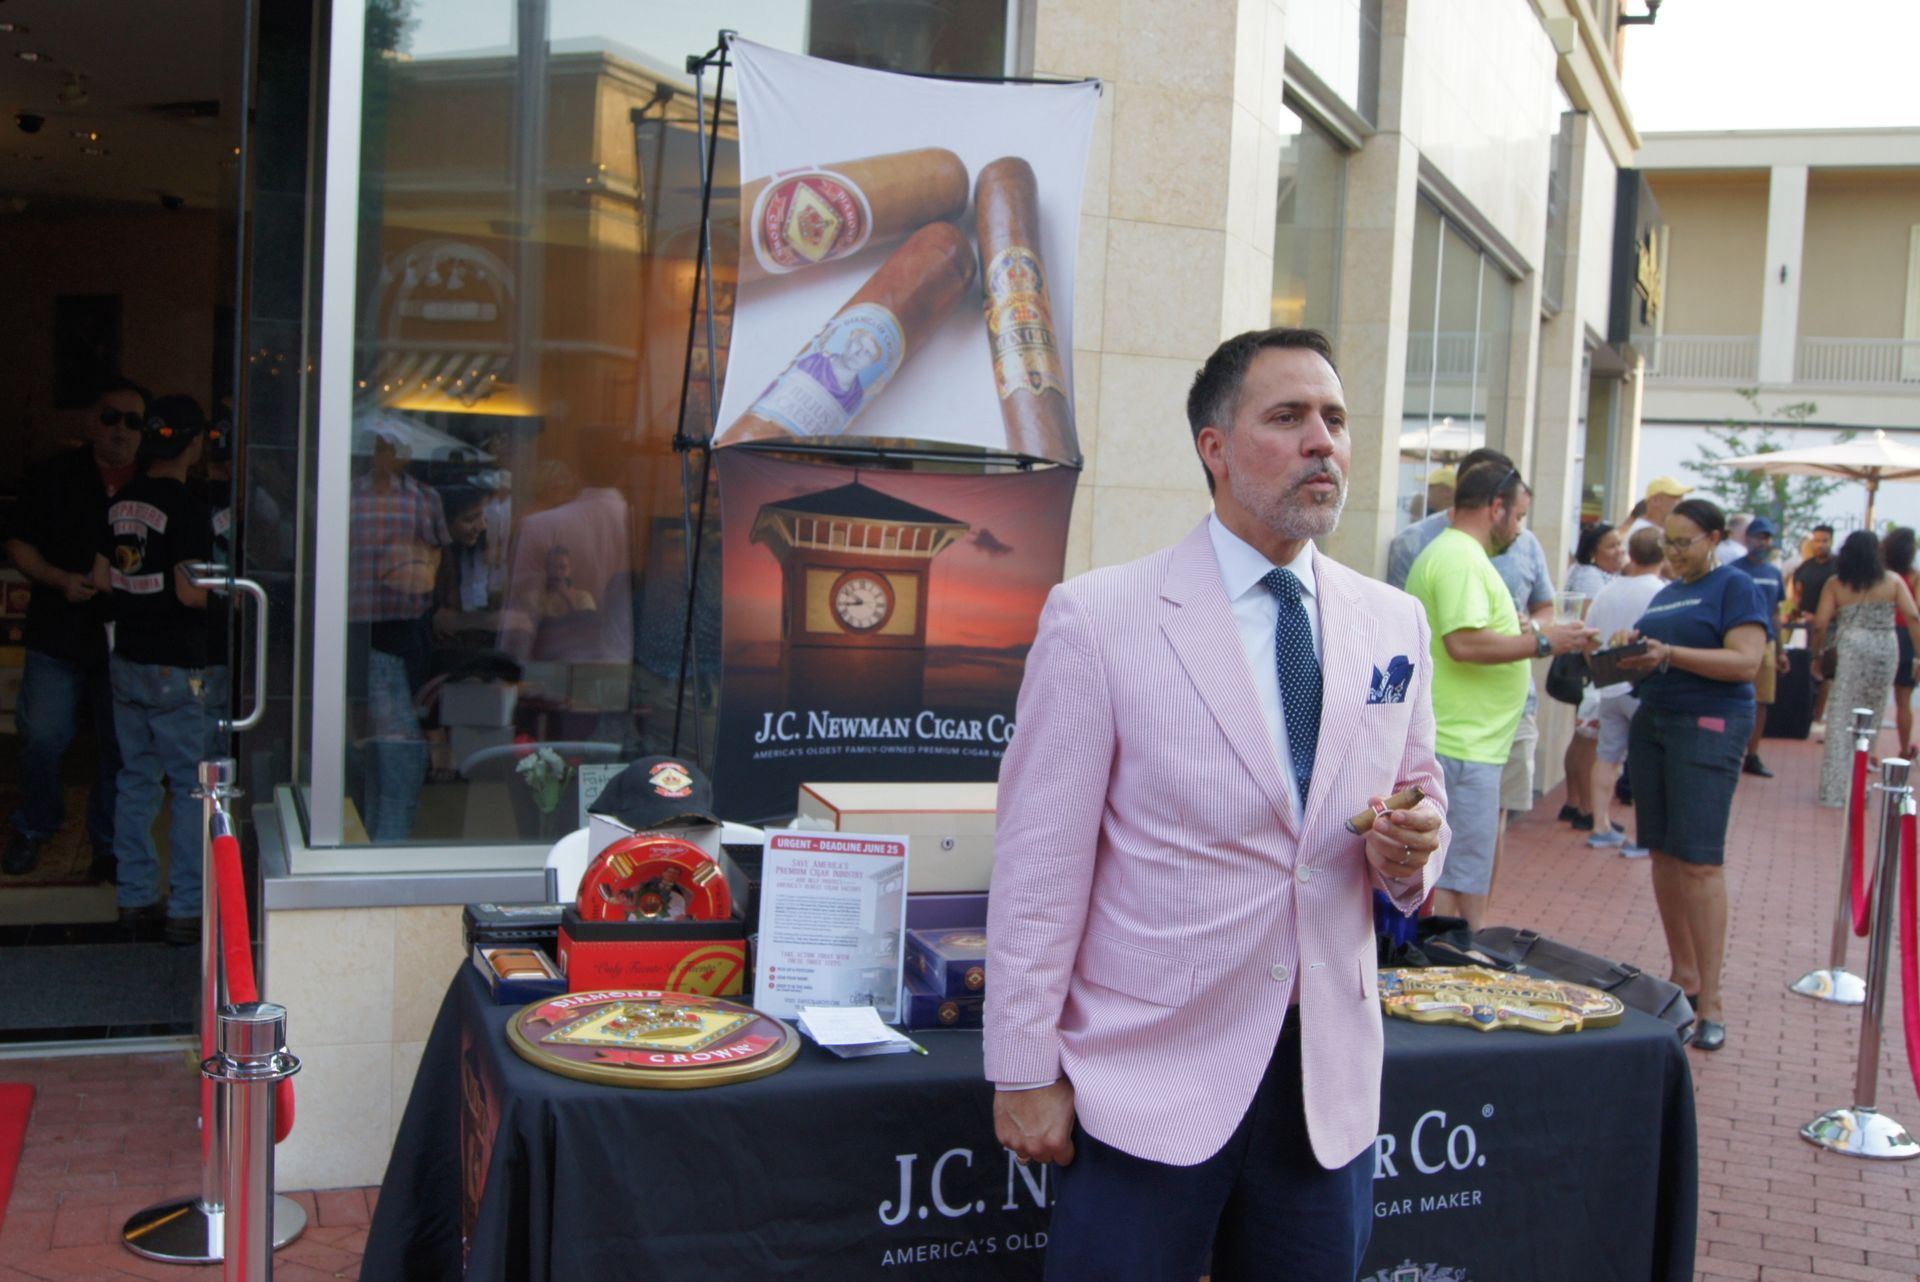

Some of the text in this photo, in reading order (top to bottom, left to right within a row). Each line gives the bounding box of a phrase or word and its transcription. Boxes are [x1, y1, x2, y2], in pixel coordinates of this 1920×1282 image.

[755, 710, 800, 744] J.C.
[806, 710, 912, 739] NEWMAN
[916, 710, 983, 741] CIGAR
[753, 748, 804, 759] AMERICA'S
[806, 746, 842, 755] OLDEST
[918, 745, 960, 755] PREMIUM
[962, 747, 990, 757] CIGAR
[776, 838, 812, 849] URGENT
[819, 841, 862, 853] DEADLINE
[863, 844, 885, 854] JUNE
[886, 845, 899, 855] 25
[550, 989, 663, 1008] DIAMOND
[649, 1043, 754, 1063] CROWN
[1373, 1133, 1399, 1179] R
[879, 1146, 1055, 1226] J.C. N
[1374, 1190, 1483, 1218] GAR MAKER
[881, 1231, 1049, 1267] AMERICA'S OLD
